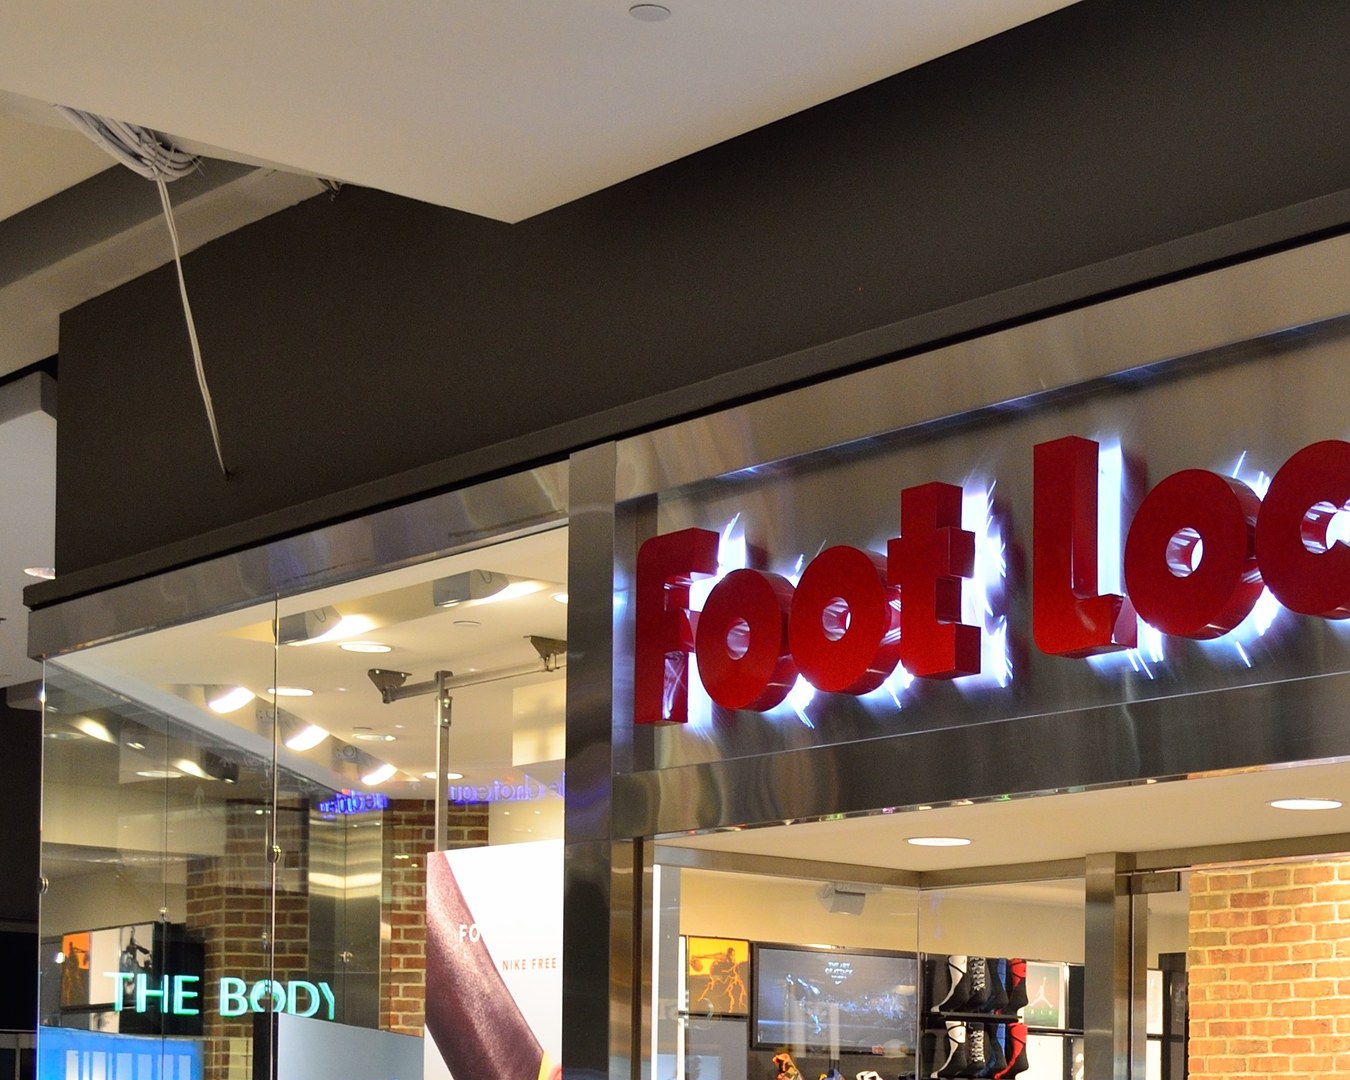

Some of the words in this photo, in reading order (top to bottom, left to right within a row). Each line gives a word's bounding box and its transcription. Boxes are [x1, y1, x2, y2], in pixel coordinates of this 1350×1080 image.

[634, 481, 982, 726] Foot
[502, 959, 526, 971] NIKE
[532, 957, 557, 969] FREE
[103, 971, 200, 1014] THE
